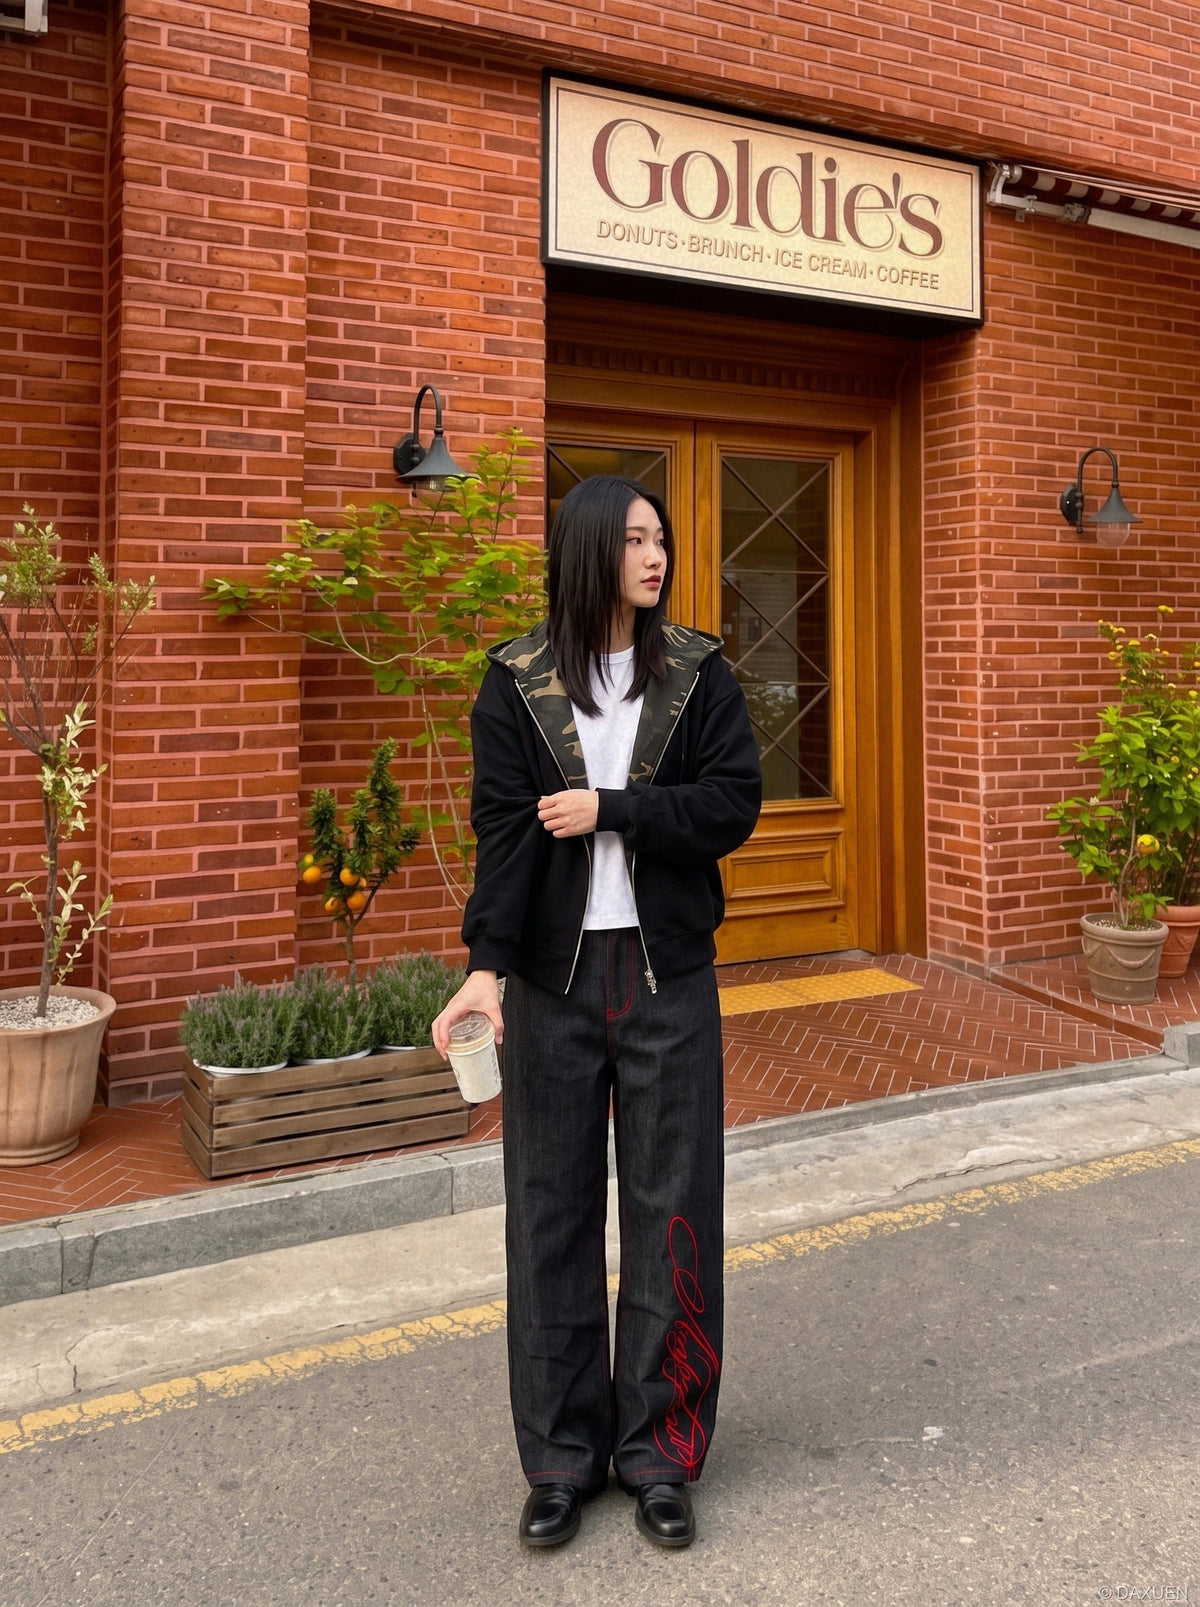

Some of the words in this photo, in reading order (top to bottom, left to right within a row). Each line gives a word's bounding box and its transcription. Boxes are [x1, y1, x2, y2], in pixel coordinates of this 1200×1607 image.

[592, 118, 944, 258] Goldie's
[596, 220, 679, 249] DONUTS
[688, 233, 764, 263] BRUNCH
[774, 248, 802, 269] ICE
[808, 254, 867, 279] CREAM
[877, 266, 939, 290] COFFEE
